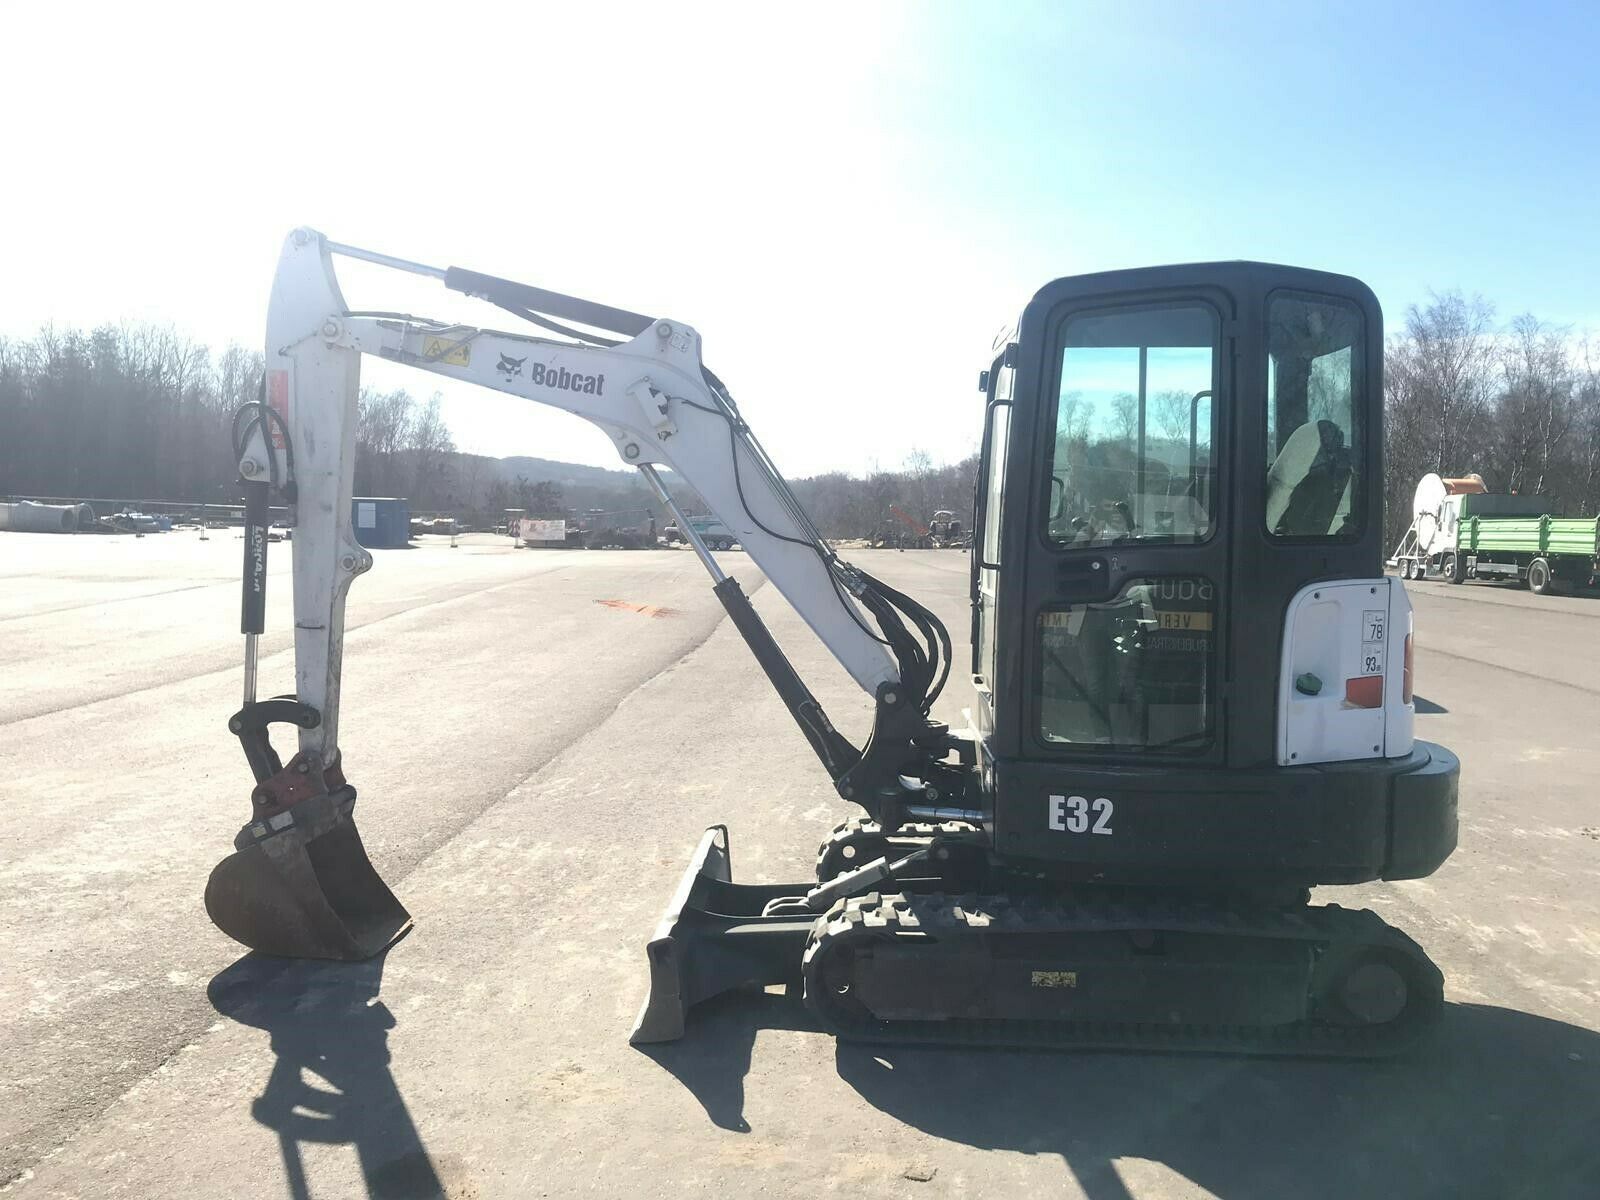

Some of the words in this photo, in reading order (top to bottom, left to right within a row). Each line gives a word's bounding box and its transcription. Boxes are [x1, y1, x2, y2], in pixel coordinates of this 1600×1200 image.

[532, 362, 605, 396] Bobcat
[1370, 624, 1383, 639] 78
[1365, 656, 1376, 672] 93
[1049, 795, 1114, 835] E32
